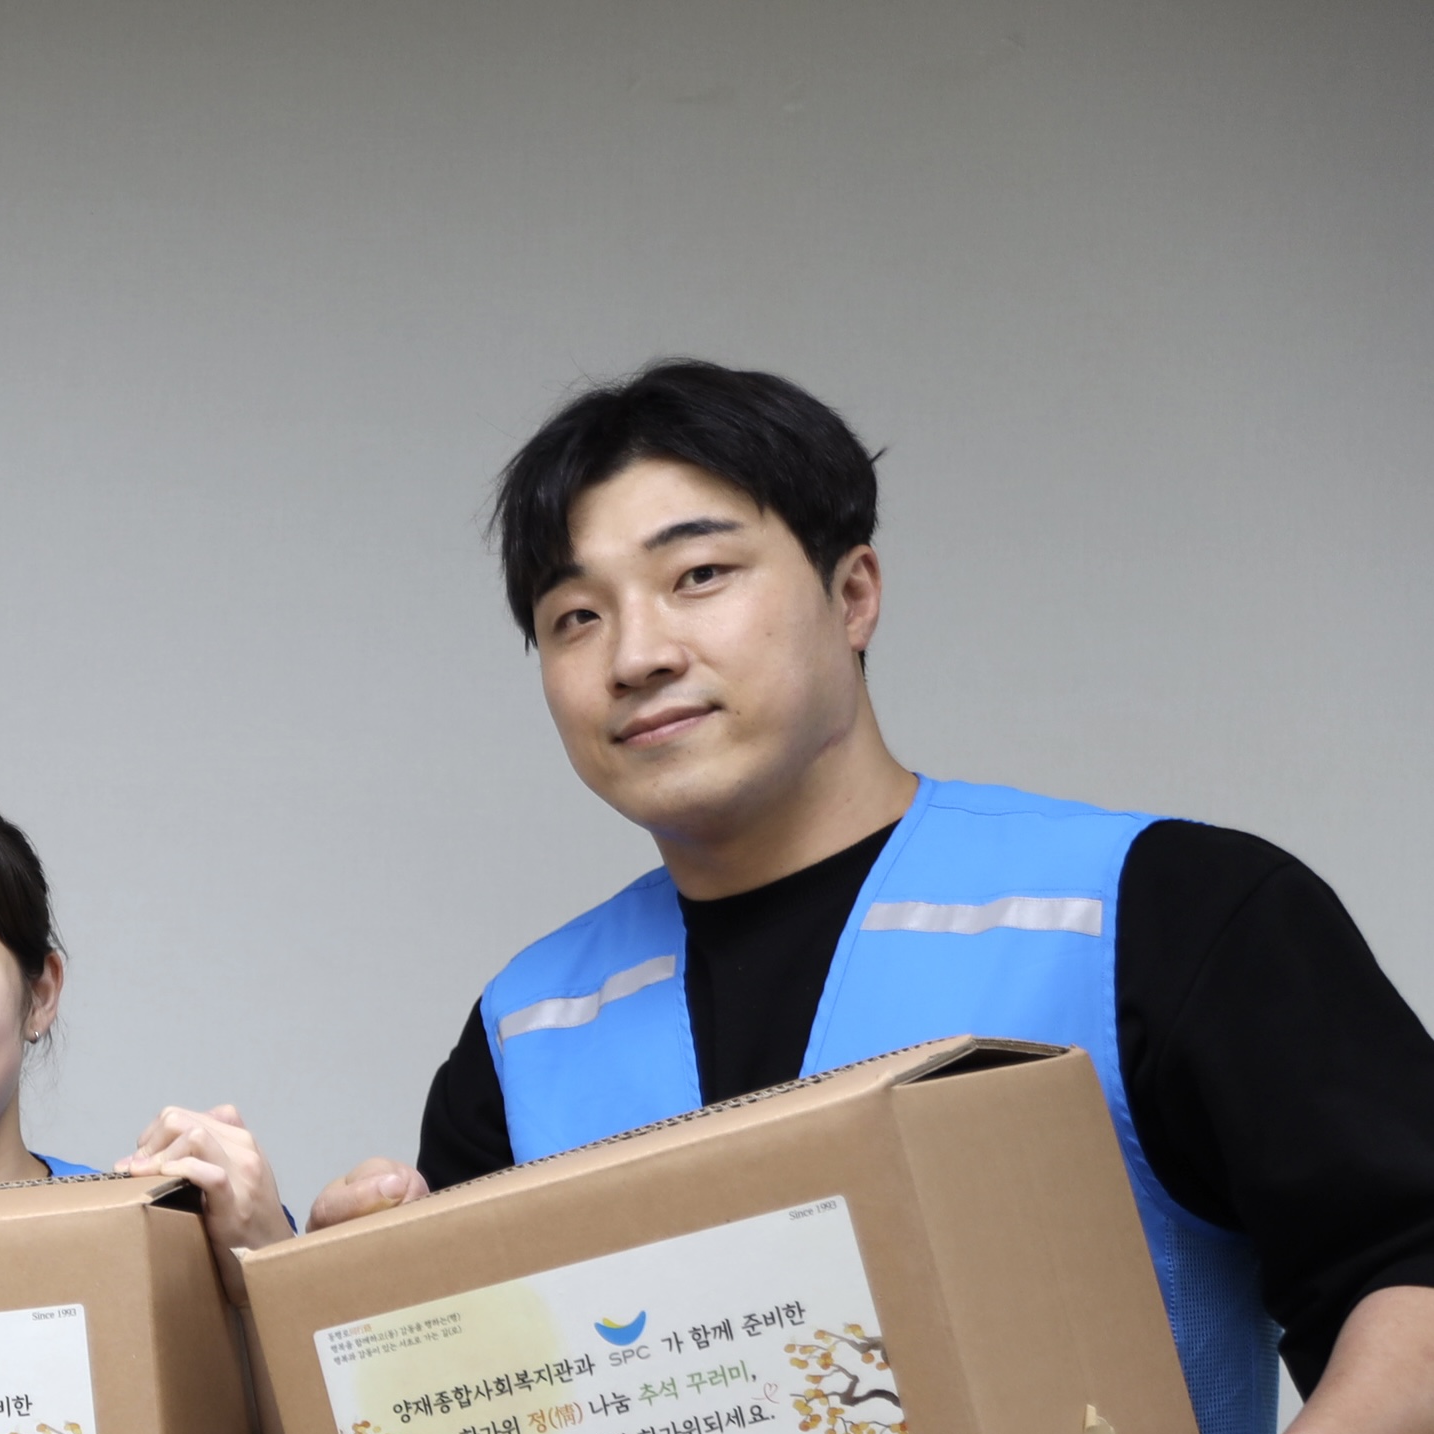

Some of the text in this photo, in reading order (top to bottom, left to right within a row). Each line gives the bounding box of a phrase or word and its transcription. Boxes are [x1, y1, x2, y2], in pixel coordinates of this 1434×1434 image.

[788, 1200, 837, 1220] Since 1993
[32, 1308, 77, 1320] Since 1993
[392, 1300, 806, 1424] 양재종합사회복지관과 SPC 가 함께 준비한
[527, 1402, 583, 1434] 정(情)
[588, 1392, 631, 1416] 나눔
[638, 1377, 679, 1406] 추석
[686, 1360, 757, 1394] 꾸러미,
